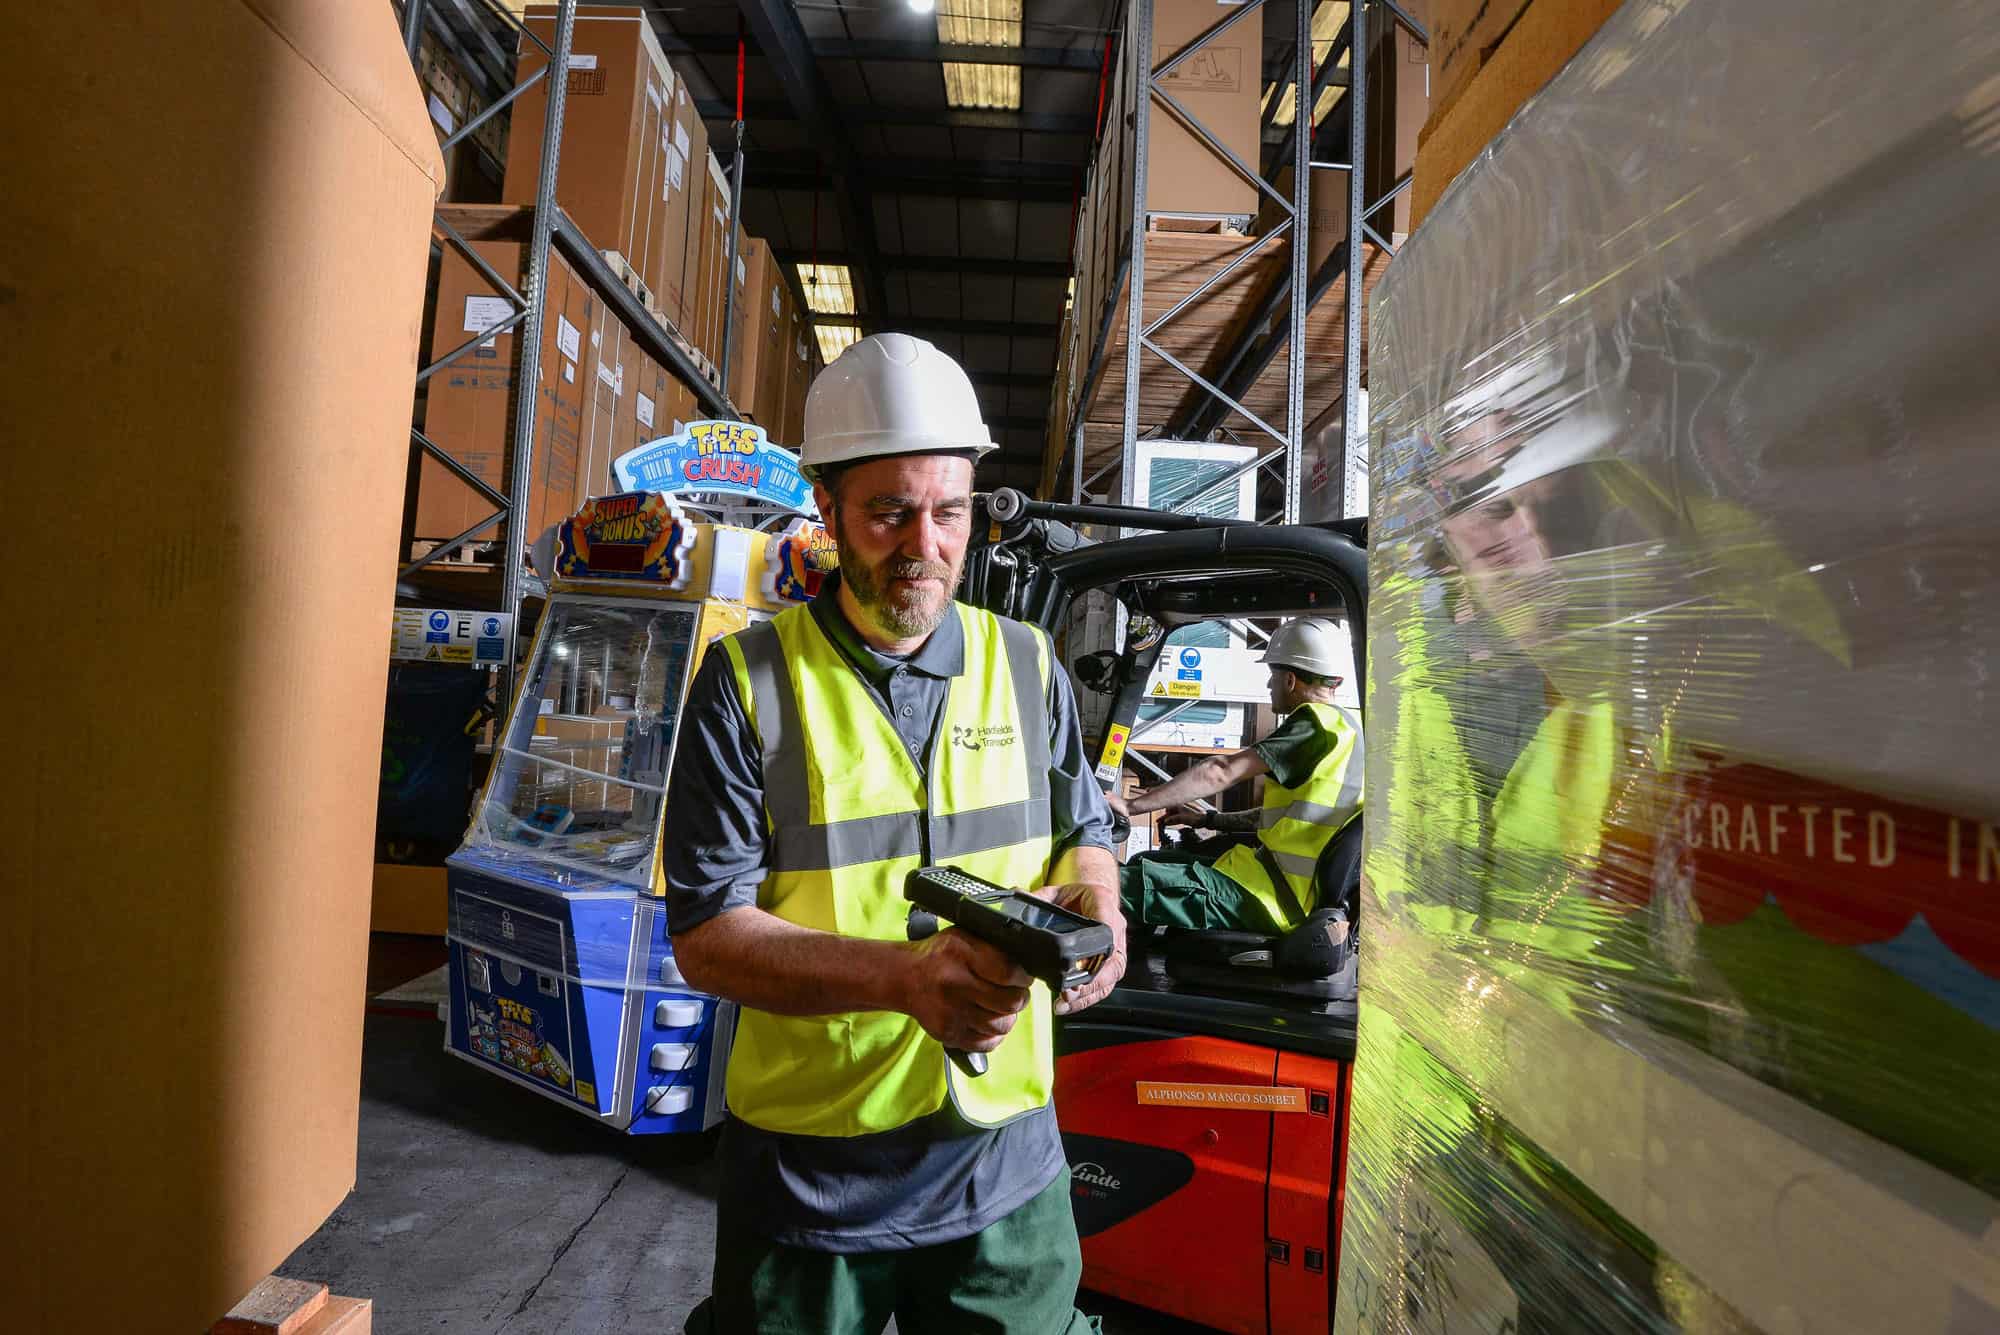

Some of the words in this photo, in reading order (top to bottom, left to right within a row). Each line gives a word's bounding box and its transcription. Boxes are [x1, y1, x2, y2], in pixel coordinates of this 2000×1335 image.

[684, 459, 760, 487] CRUSH
[595, 496, 638, 522] SUPER
[601, 511, 647, 542] BONUS
[457, 620, 471, 638] E
[1158, 654, 1171, 672] F
[1684, 802, 1896, 867] CRAFTED
[1146, 1090, 1205, 1101] ALPHONSO
[1207, 1094, 1250, 1104] MANGO
[1253, 1095, 1297, 1105] SORBET
